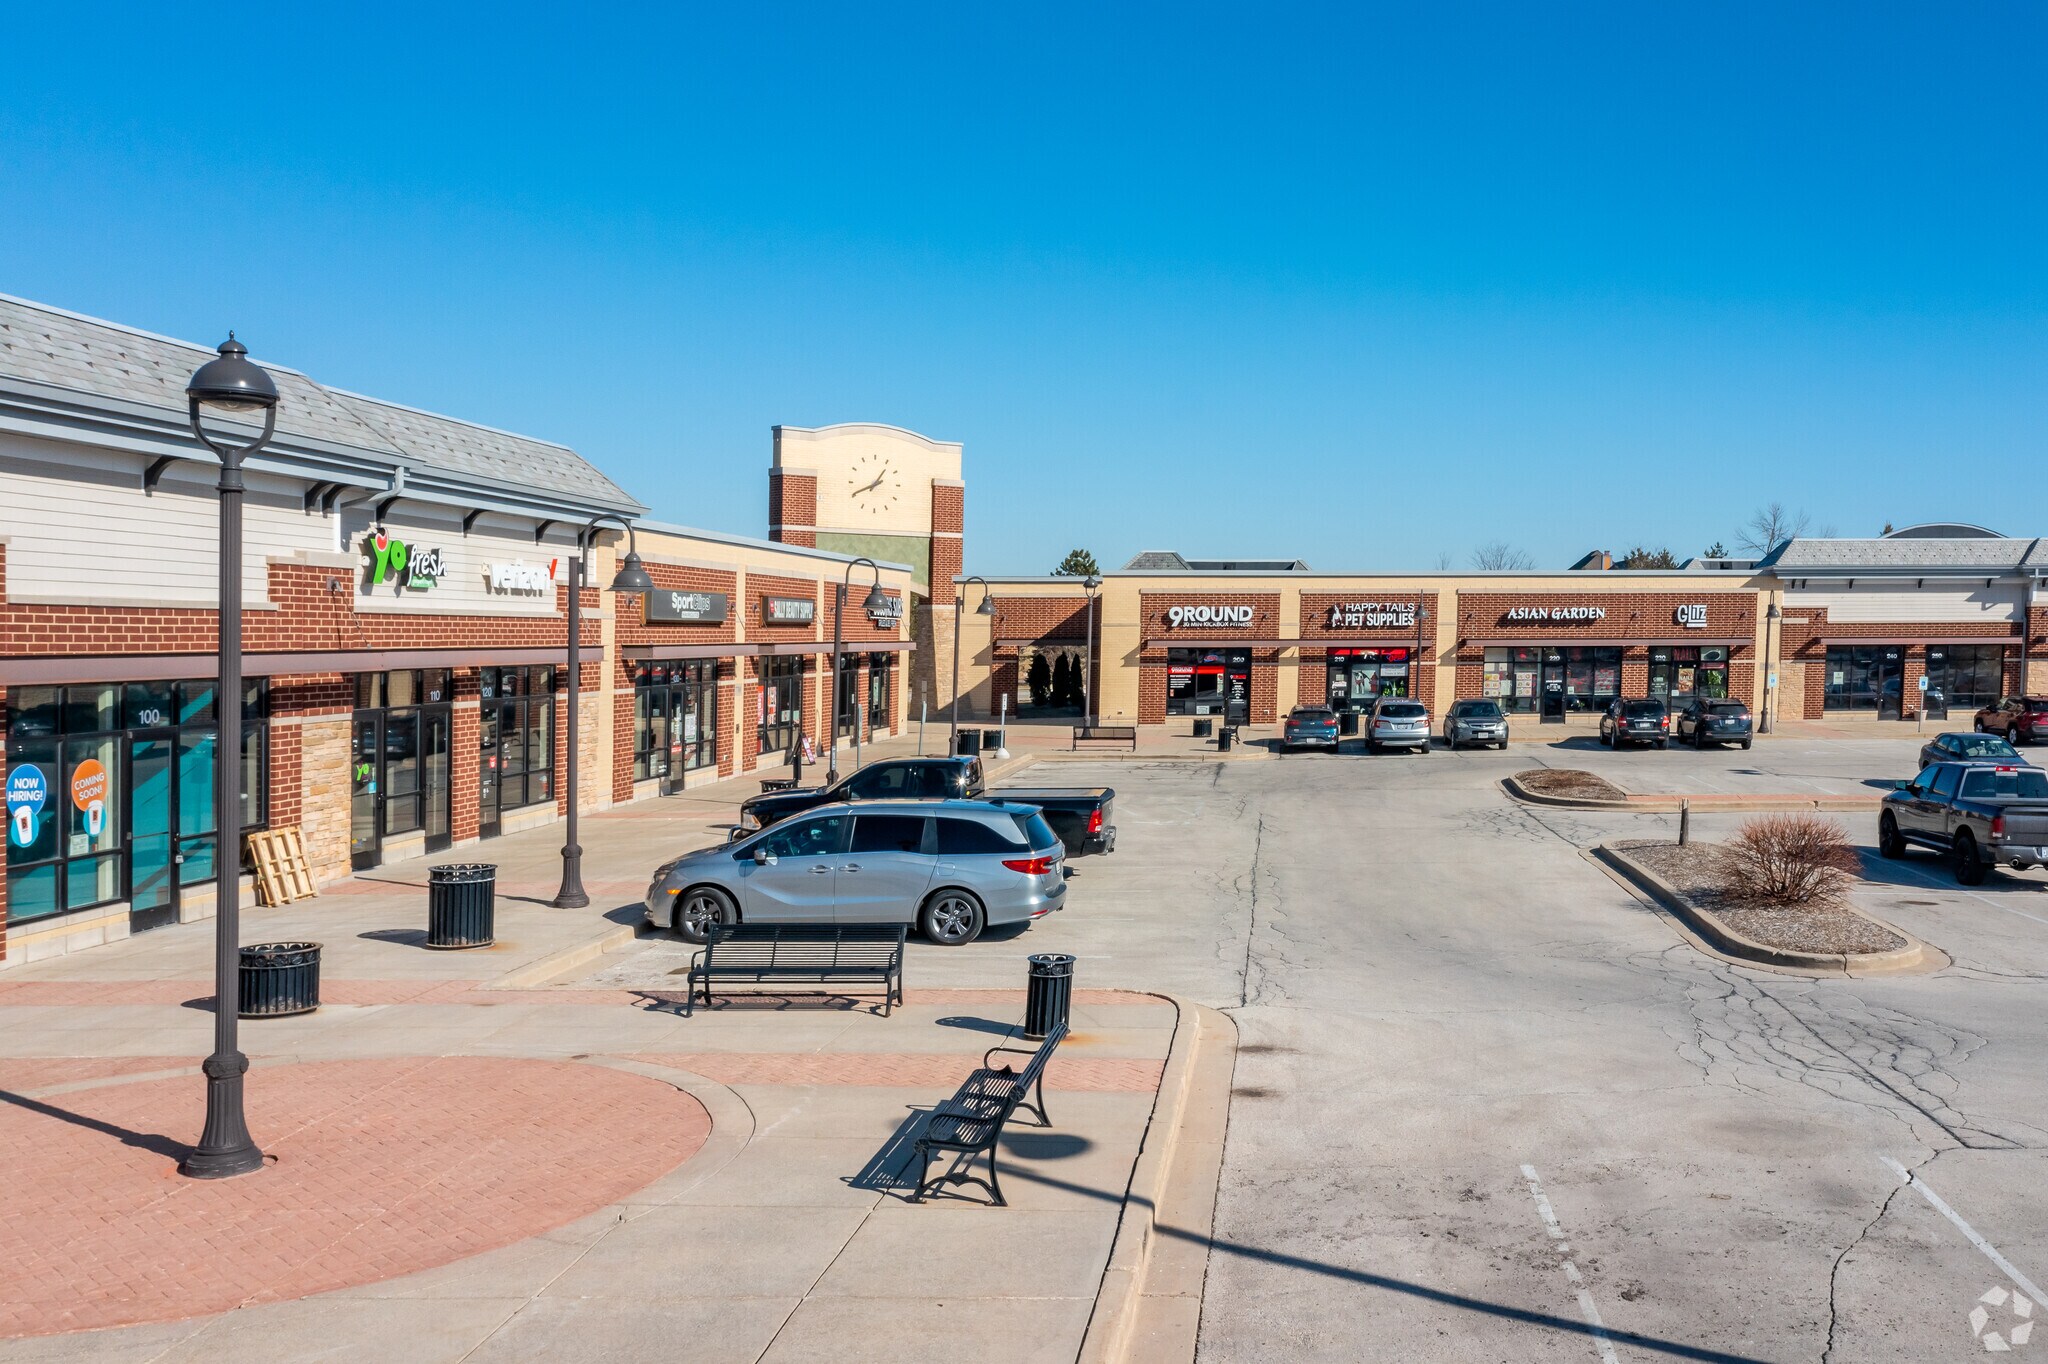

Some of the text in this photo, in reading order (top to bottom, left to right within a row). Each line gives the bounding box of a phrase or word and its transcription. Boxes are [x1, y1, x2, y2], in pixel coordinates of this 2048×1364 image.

[407, 543, 448, 588] fresh
[491, 558, 551, 590] verizon
[1345, 602, 1415, 612] HAPPY TAILS
[1507, 607, 1605, 620] ASIAN GARDEN
[1168, 605, 1253, 627] 9ROUND
[1345, 612, 1415, 626] PET SUPPLIES
[430, 690, 441, 701] 110
[482, 686, 492, 698] 120
[138, 709, 160, 725] 100
[14, 778, 39, 789] NOW
[74, 772, 105, 791] COMING
[8, 790, 43, 802] HIRING!
[78, 785, 103, 801] SOON!
